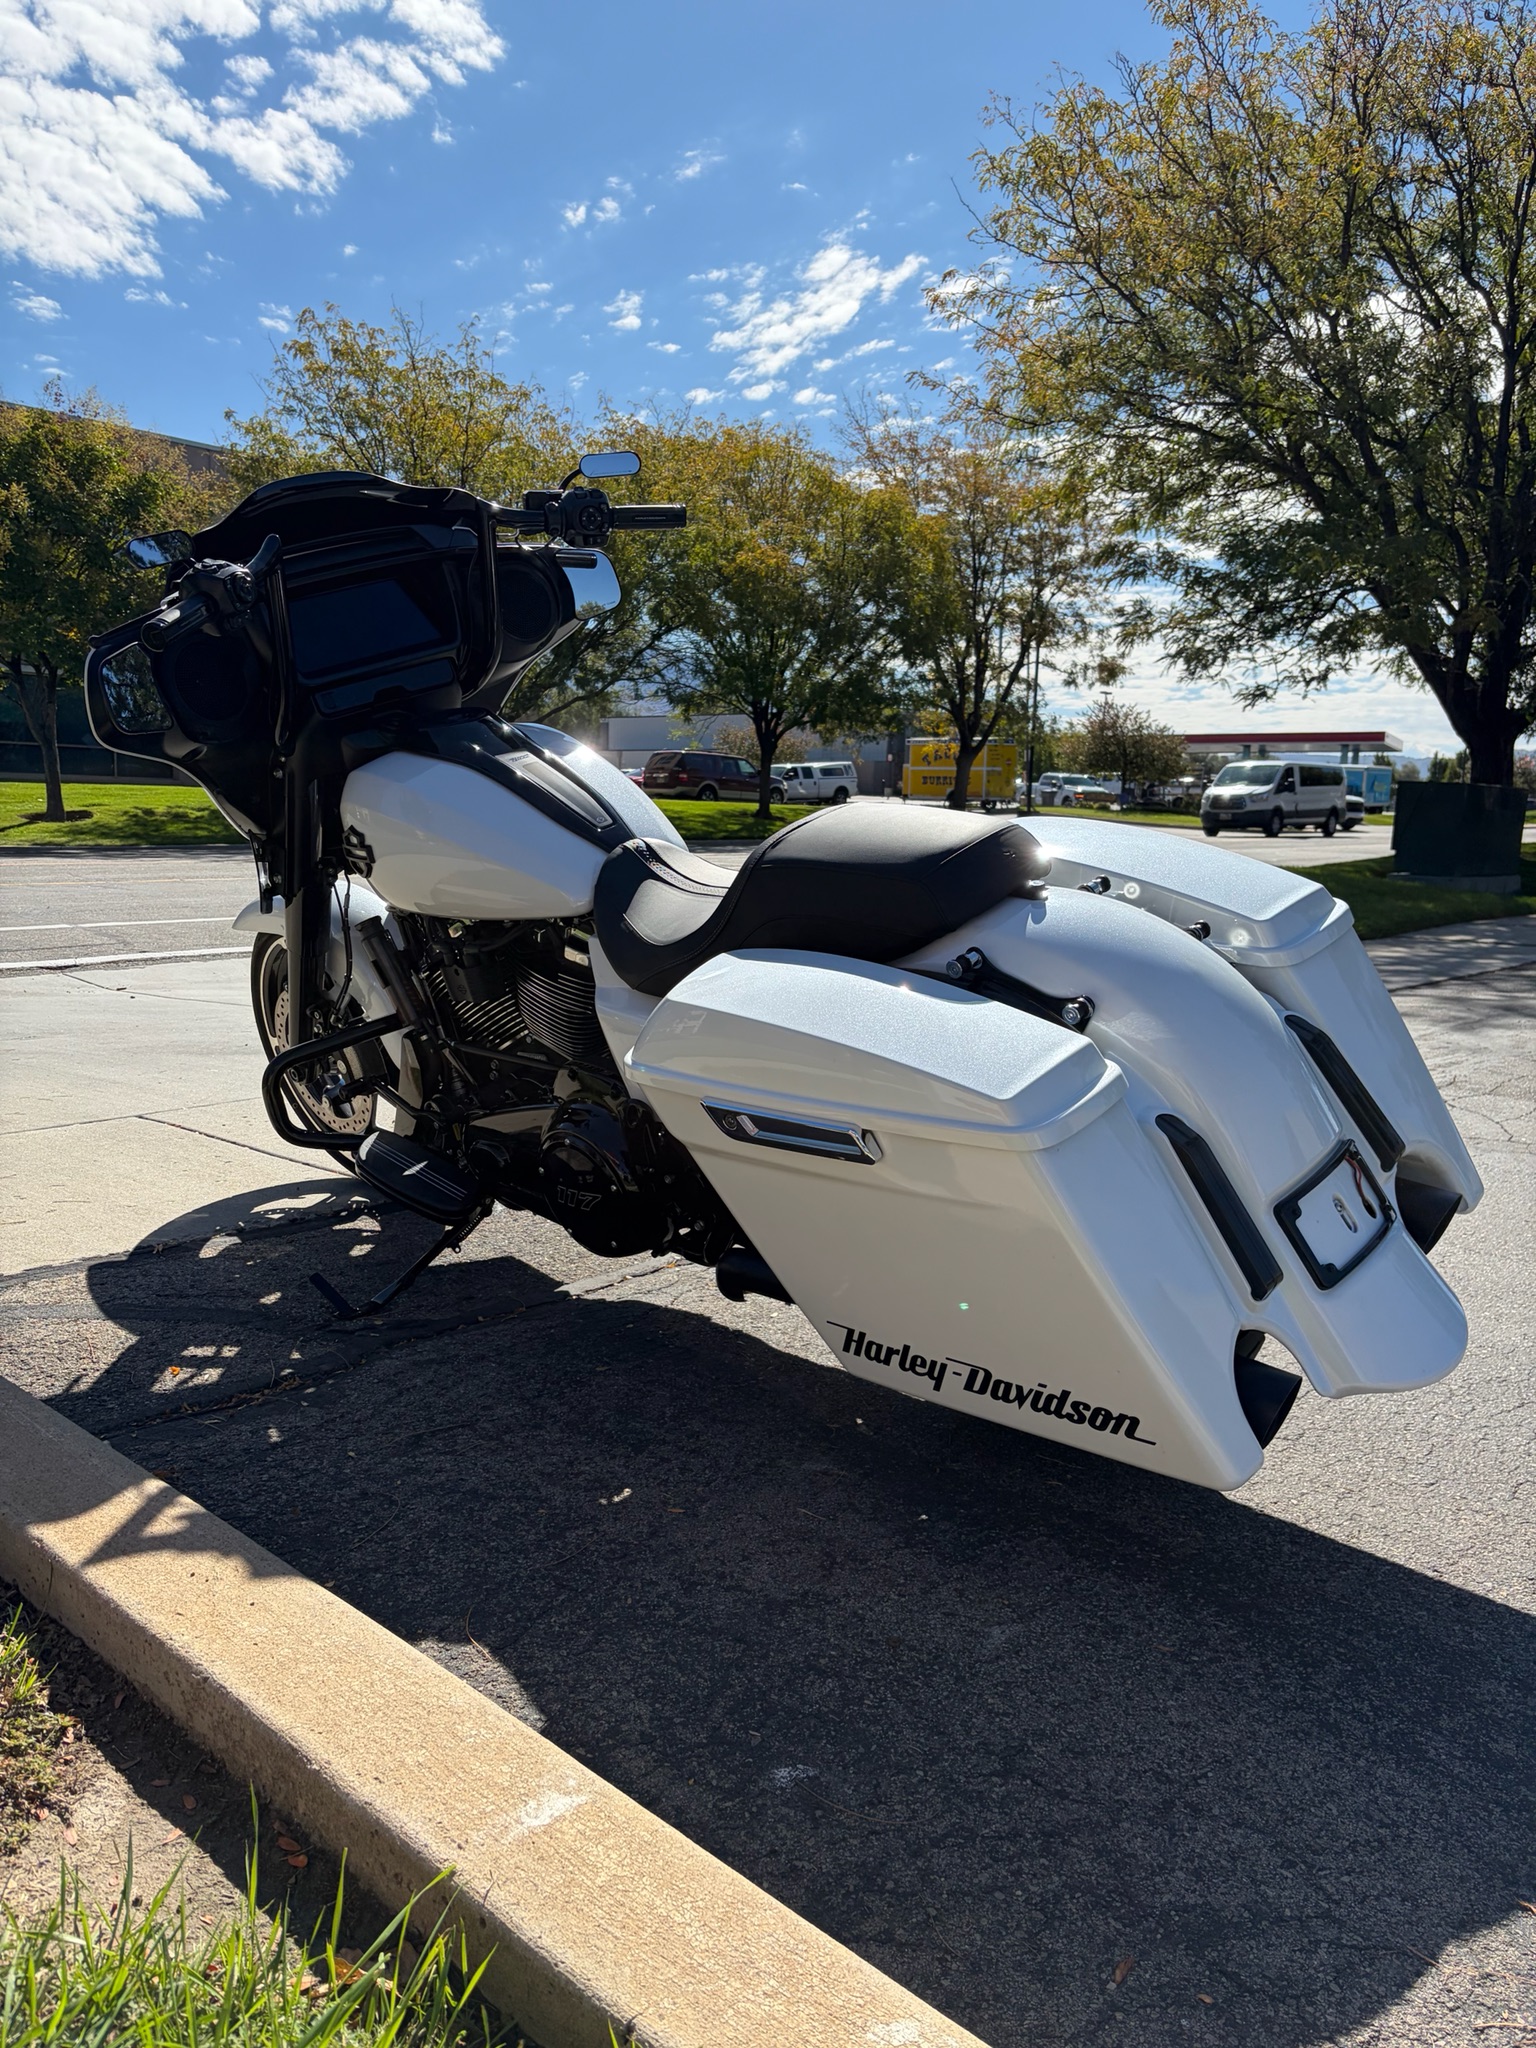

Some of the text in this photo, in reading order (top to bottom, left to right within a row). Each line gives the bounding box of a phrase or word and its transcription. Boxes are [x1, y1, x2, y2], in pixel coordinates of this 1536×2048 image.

[921, 775, 971, 786] BURRI
[556, 1184, 603, 1211] 117
[826, 1320, 1157, 1446] Harley-Davidson
